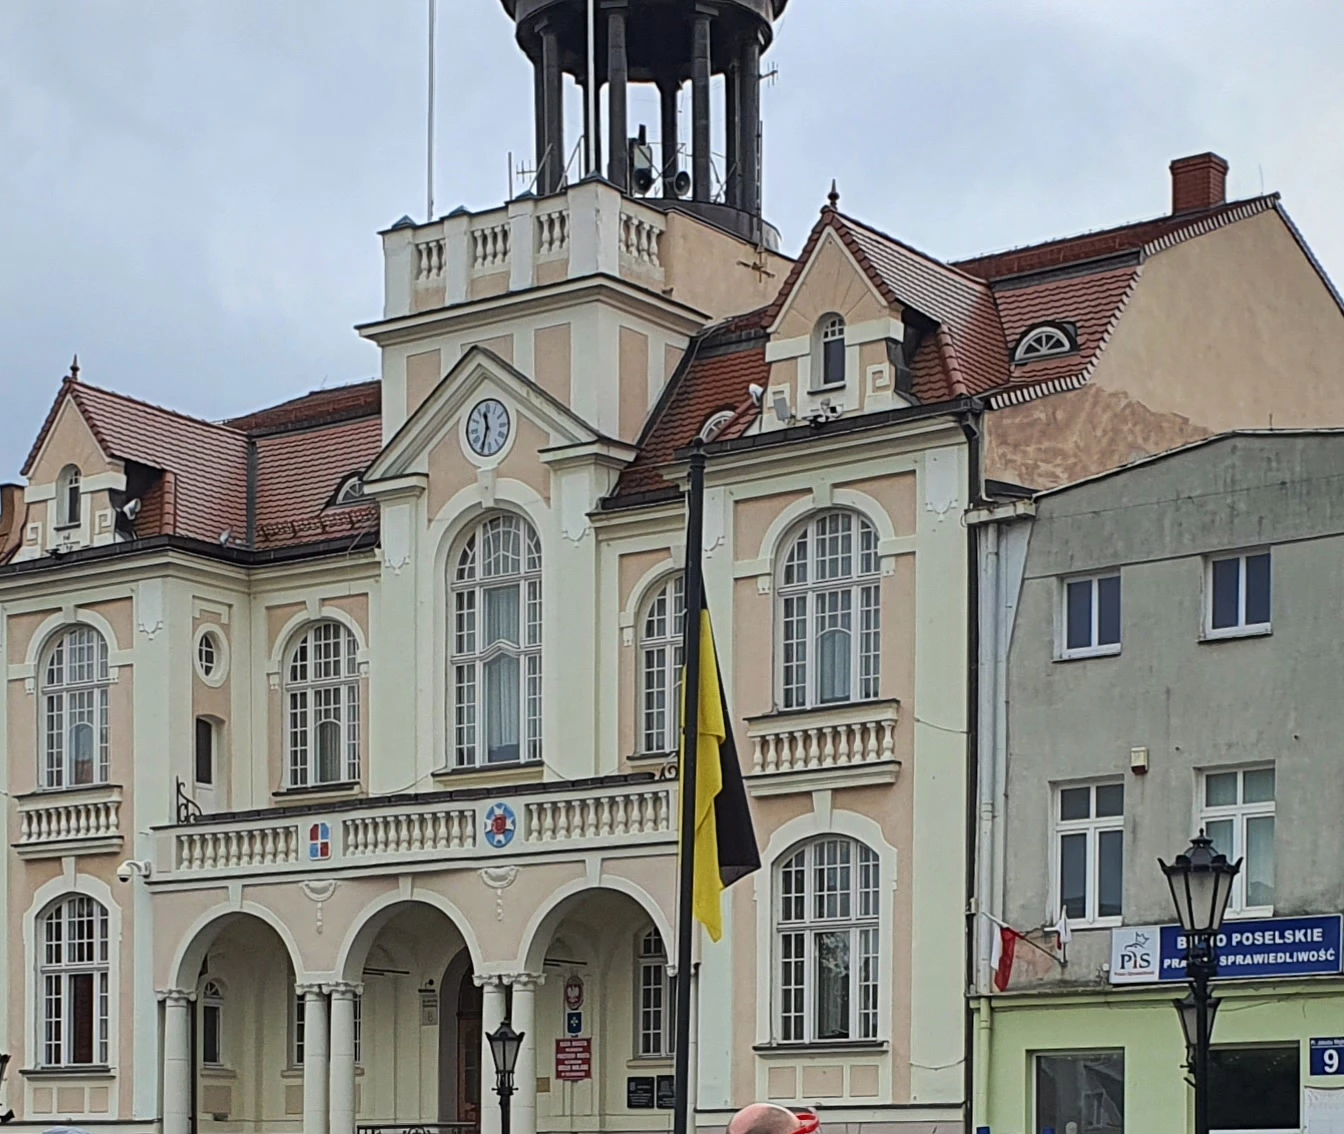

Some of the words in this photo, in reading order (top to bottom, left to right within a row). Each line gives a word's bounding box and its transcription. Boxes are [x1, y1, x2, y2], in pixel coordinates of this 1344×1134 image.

[1232, 928, 1323, 946] POSELSKIE
[1119, 951, 1151, 970] PiS
[1219, 947, 1336, 967] SPRAWIEDLIWOŚĆ
[1323, 1049, 1339, 1073] 9
